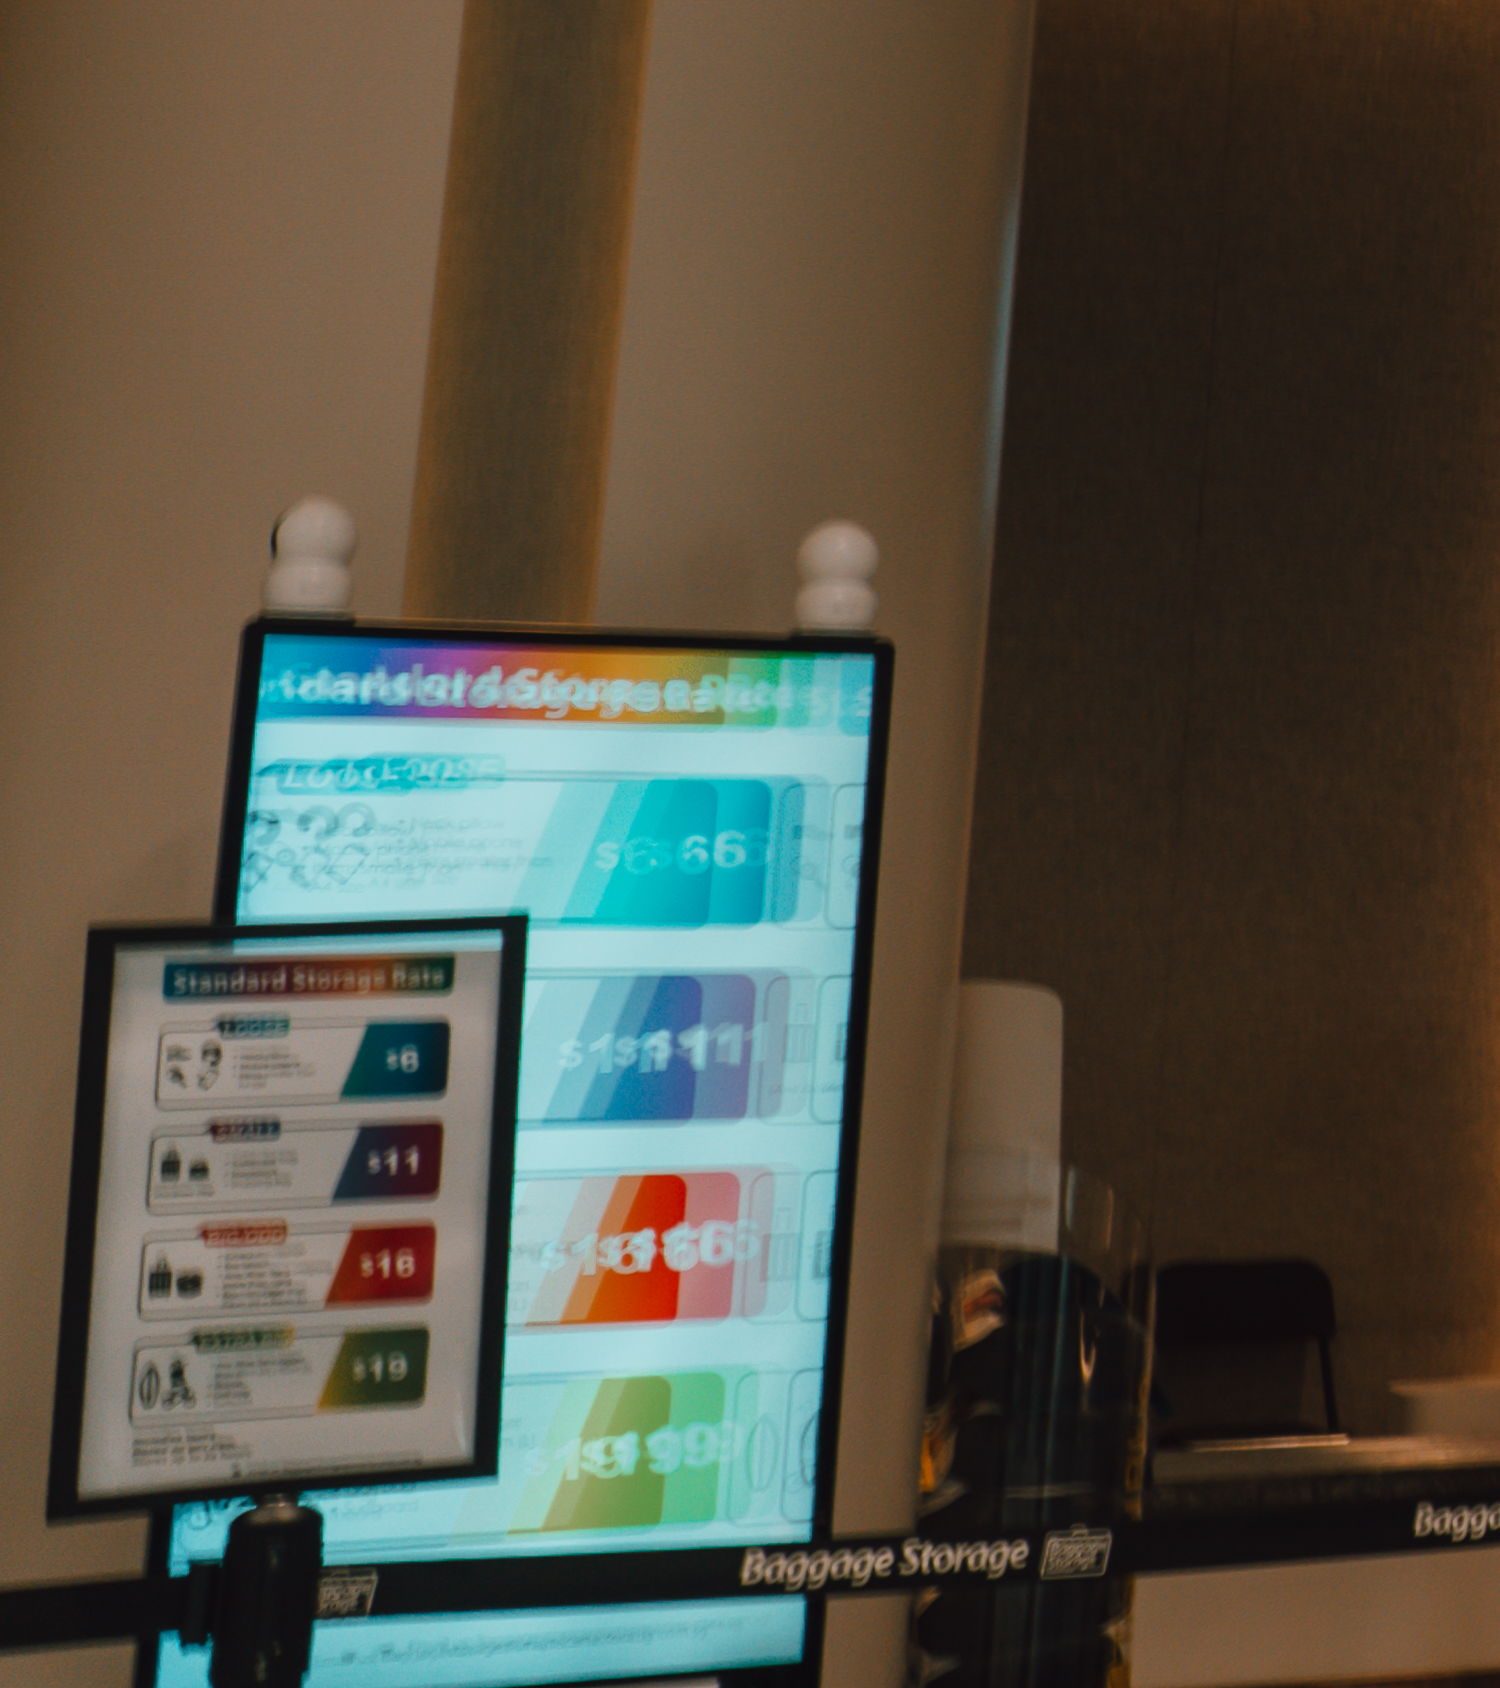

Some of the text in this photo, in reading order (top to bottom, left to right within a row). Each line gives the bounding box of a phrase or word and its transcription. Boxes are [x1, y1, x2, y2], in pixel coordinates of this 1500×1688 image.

[172, 957, 446, 995] Standard Storage Rate
[366, 1144, 420, 1176] $11
[739, 1535, 1031, 1592] Baggage Storage
